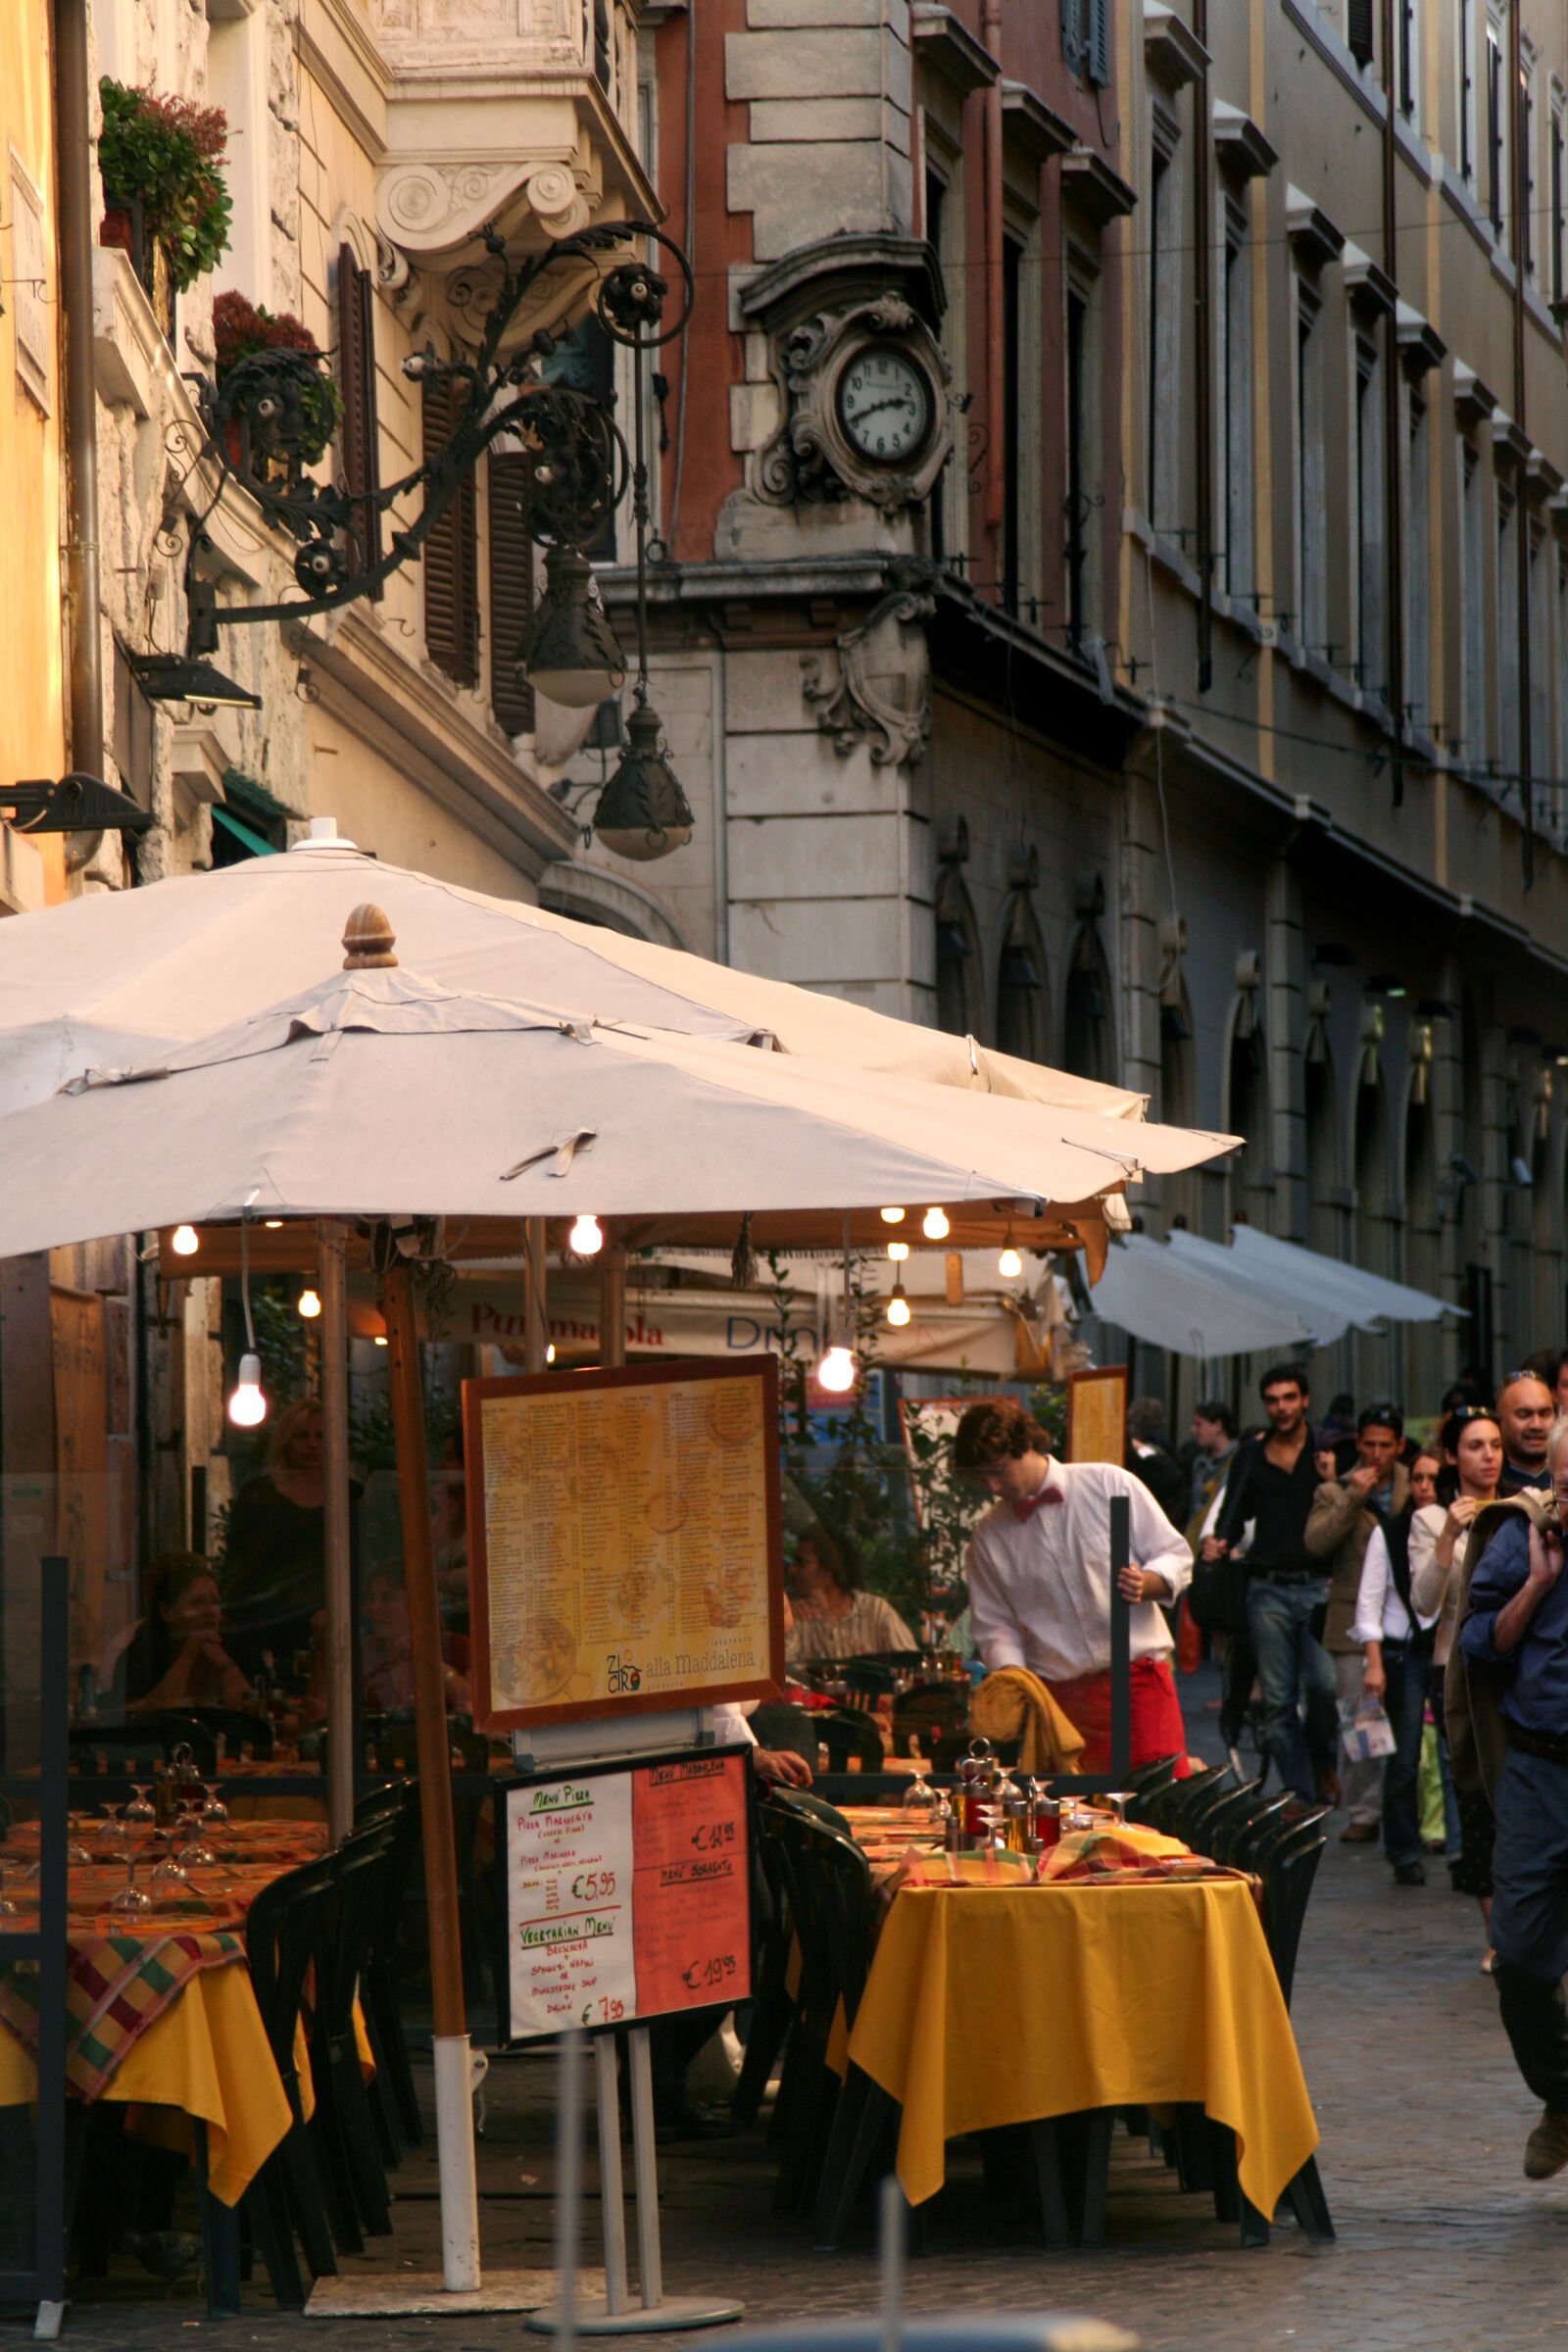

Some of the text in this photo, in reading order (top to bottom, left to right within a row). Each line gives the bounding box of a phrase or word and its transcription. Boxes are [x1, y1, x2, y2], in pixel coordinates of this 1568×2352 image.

[851, 376, 862, 391] 10
[904, 383, 911, 397] 2
[846, 394, 855, 409] 9
[903, 422, 910, 434] 4
[862, 430, 870, 445] 7
[877, 436, 885, 451] 6
[892, 433, 901, 448] 5
[646, 1655, 672, 1679] alla
[520, 1921, 580, 1943] VEGETARIAN
